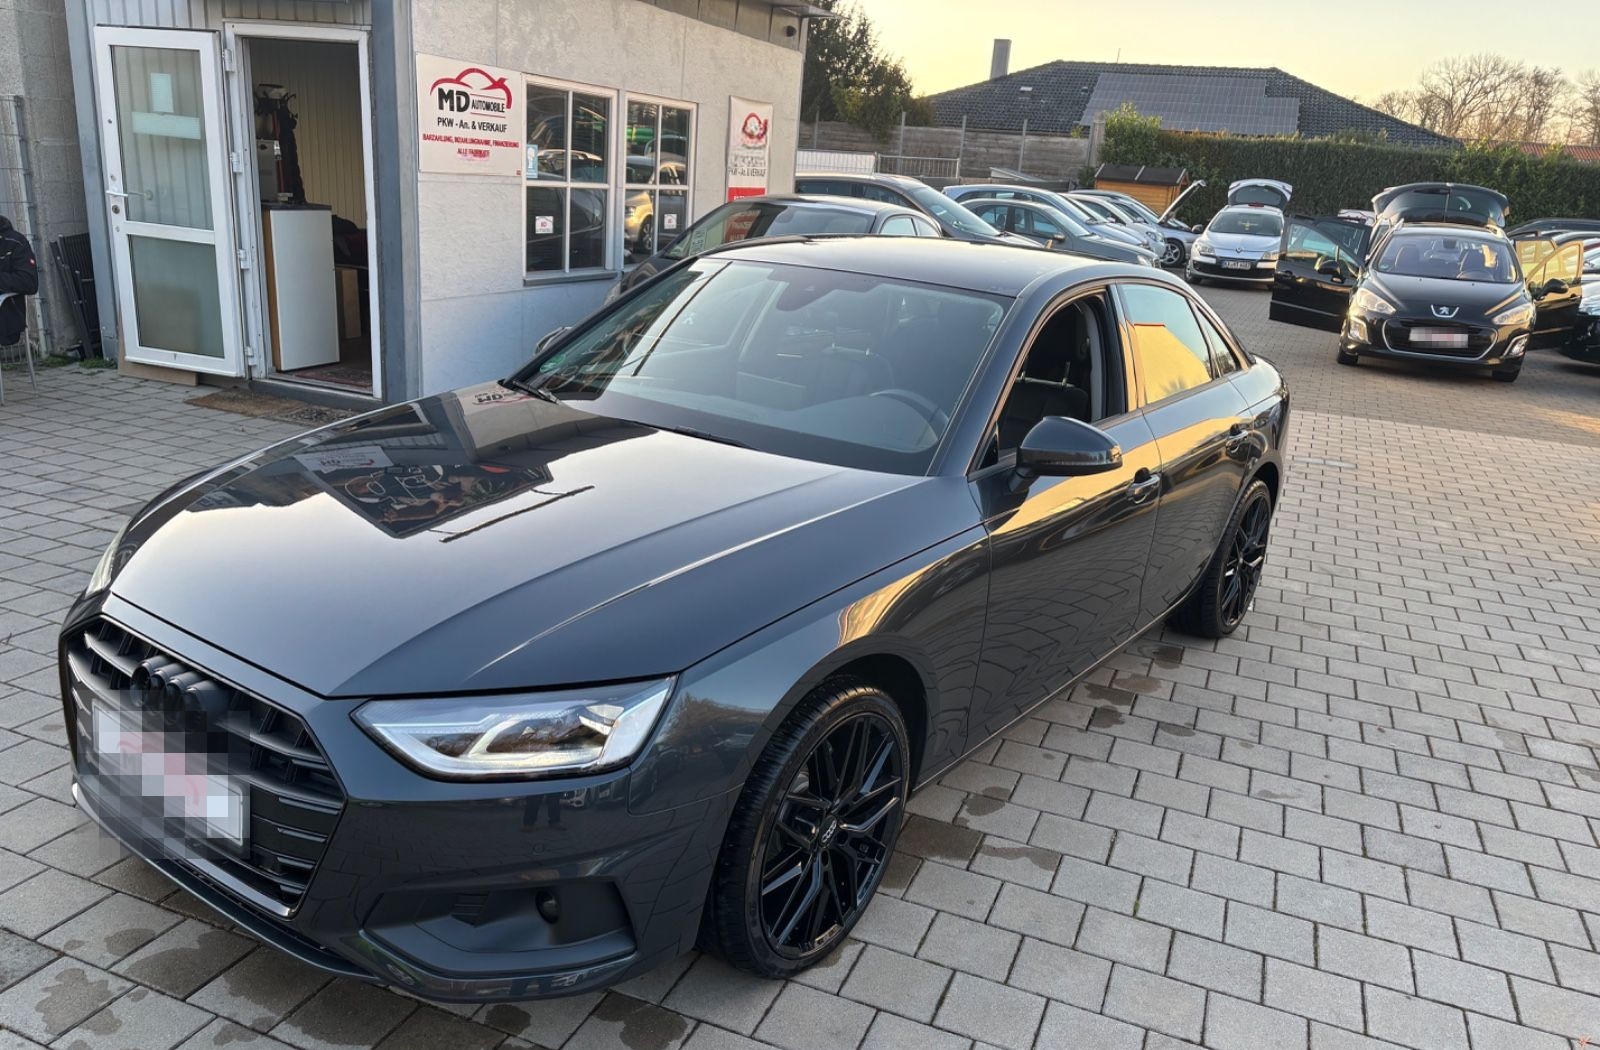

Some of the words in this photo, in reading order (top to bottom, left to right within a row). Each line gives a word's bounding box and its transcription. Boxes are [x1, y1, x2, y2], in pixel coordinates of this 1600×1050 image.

[438, 87, 470, 112] MD
[471, 99, 505, 113] AUTOMOBILE
[437, 117, 453, 128] PKW
[471, 121, 477, 130] &
[478, 122, 507, 133] VERKAUF
